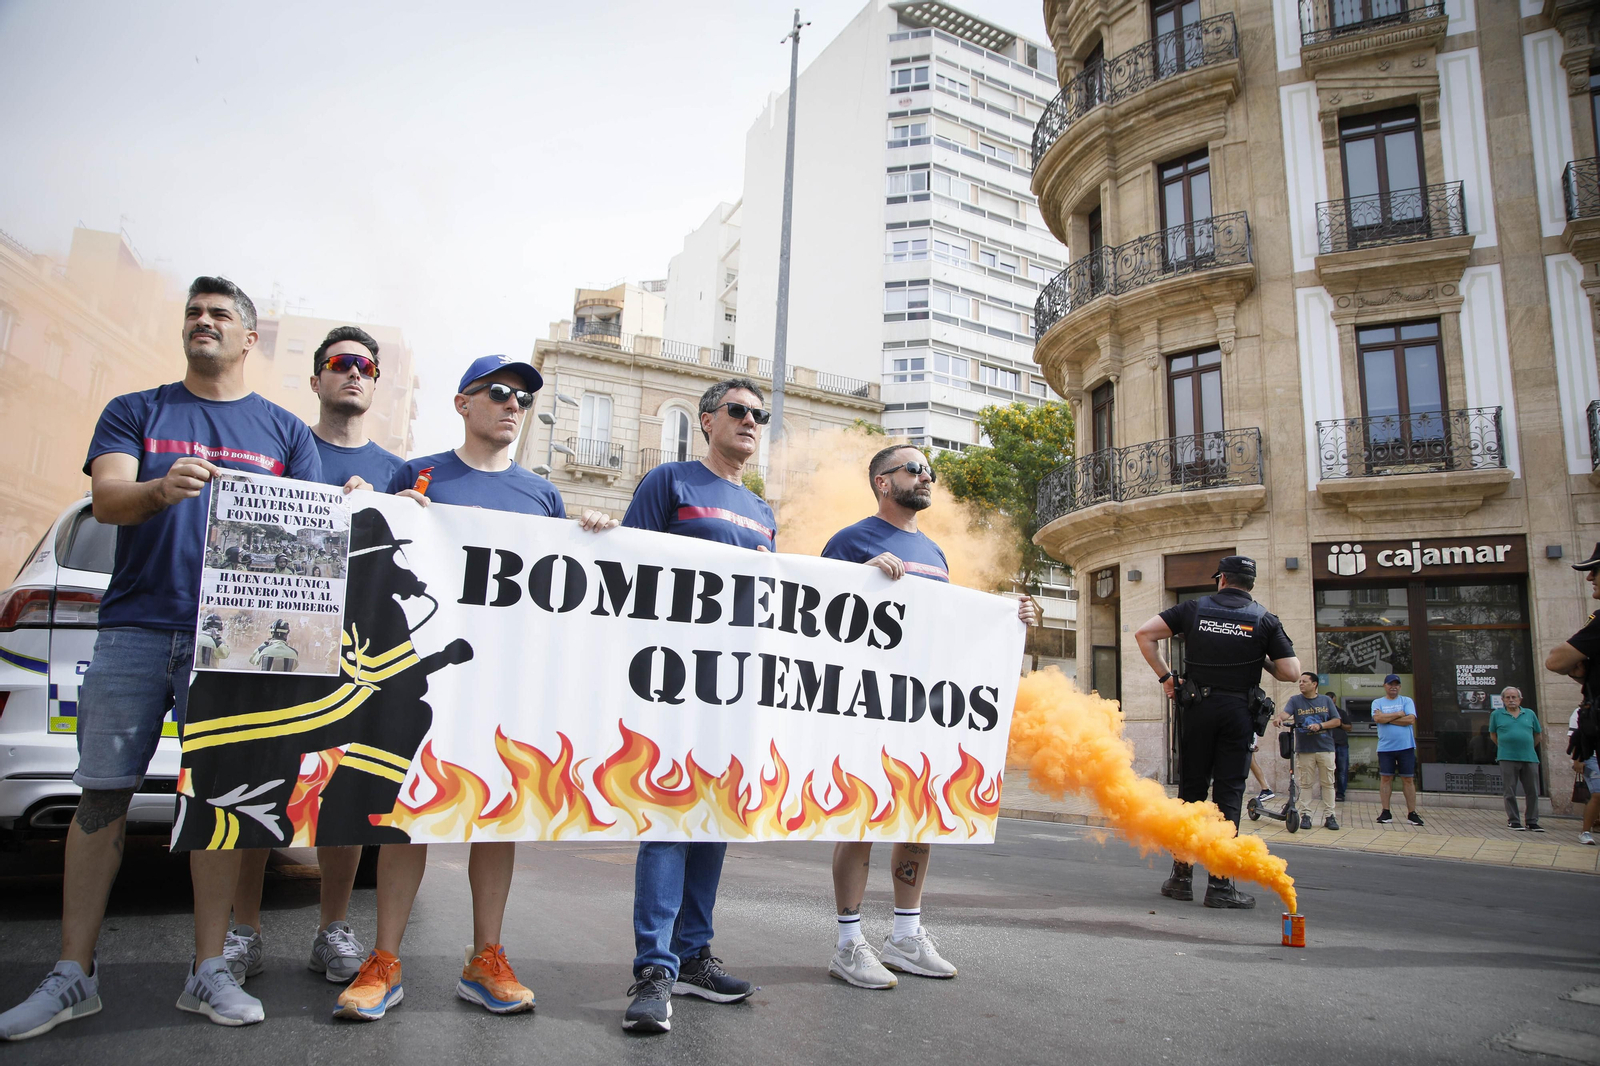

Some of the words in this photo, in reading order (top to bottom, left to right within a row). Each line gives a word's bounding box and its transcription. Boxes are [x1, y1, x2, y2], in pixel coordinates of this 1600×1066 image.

[231, 451, 275, 468] BOMBEROS
[221, 481, 237, 493] EL
[241, 483, 343, 505] AYUNTAMIENTO
[233, 496, 303, 513] MALVERSA
[307, 504, 331, 516] LOS
[226, 509, 280, 524] FONDOS
[283, 515, 334, 530] UNESPA
[1377, 541, 1512, 574] cajamar
[220, 572, 261, 584] HACEN
[263, 575, 292, 587] CAJA
[295, 576, 331, 590] ÚNICA
[215, 584, 230, 594] EL
[233, 585, 279, 598] DINERO
[281, 589, 298, 599] NO
[300, 590, 315, 601] VA
[317, 591, 333, 602] AL
[457, 545, 906, 650] BOMBEROS
[205, 595, 255, 608] PARQUE
[258, 599, 273, 610] DE
[276, 600, 340, 614] BOMBEROS
[1198, 625, 1252, 638] NACIONAL
[1199, 619, 1242, 631] POLICIA
[628, 646, 999, 731] QUEMADOS
[1297, 707, 1315, 716] Death
